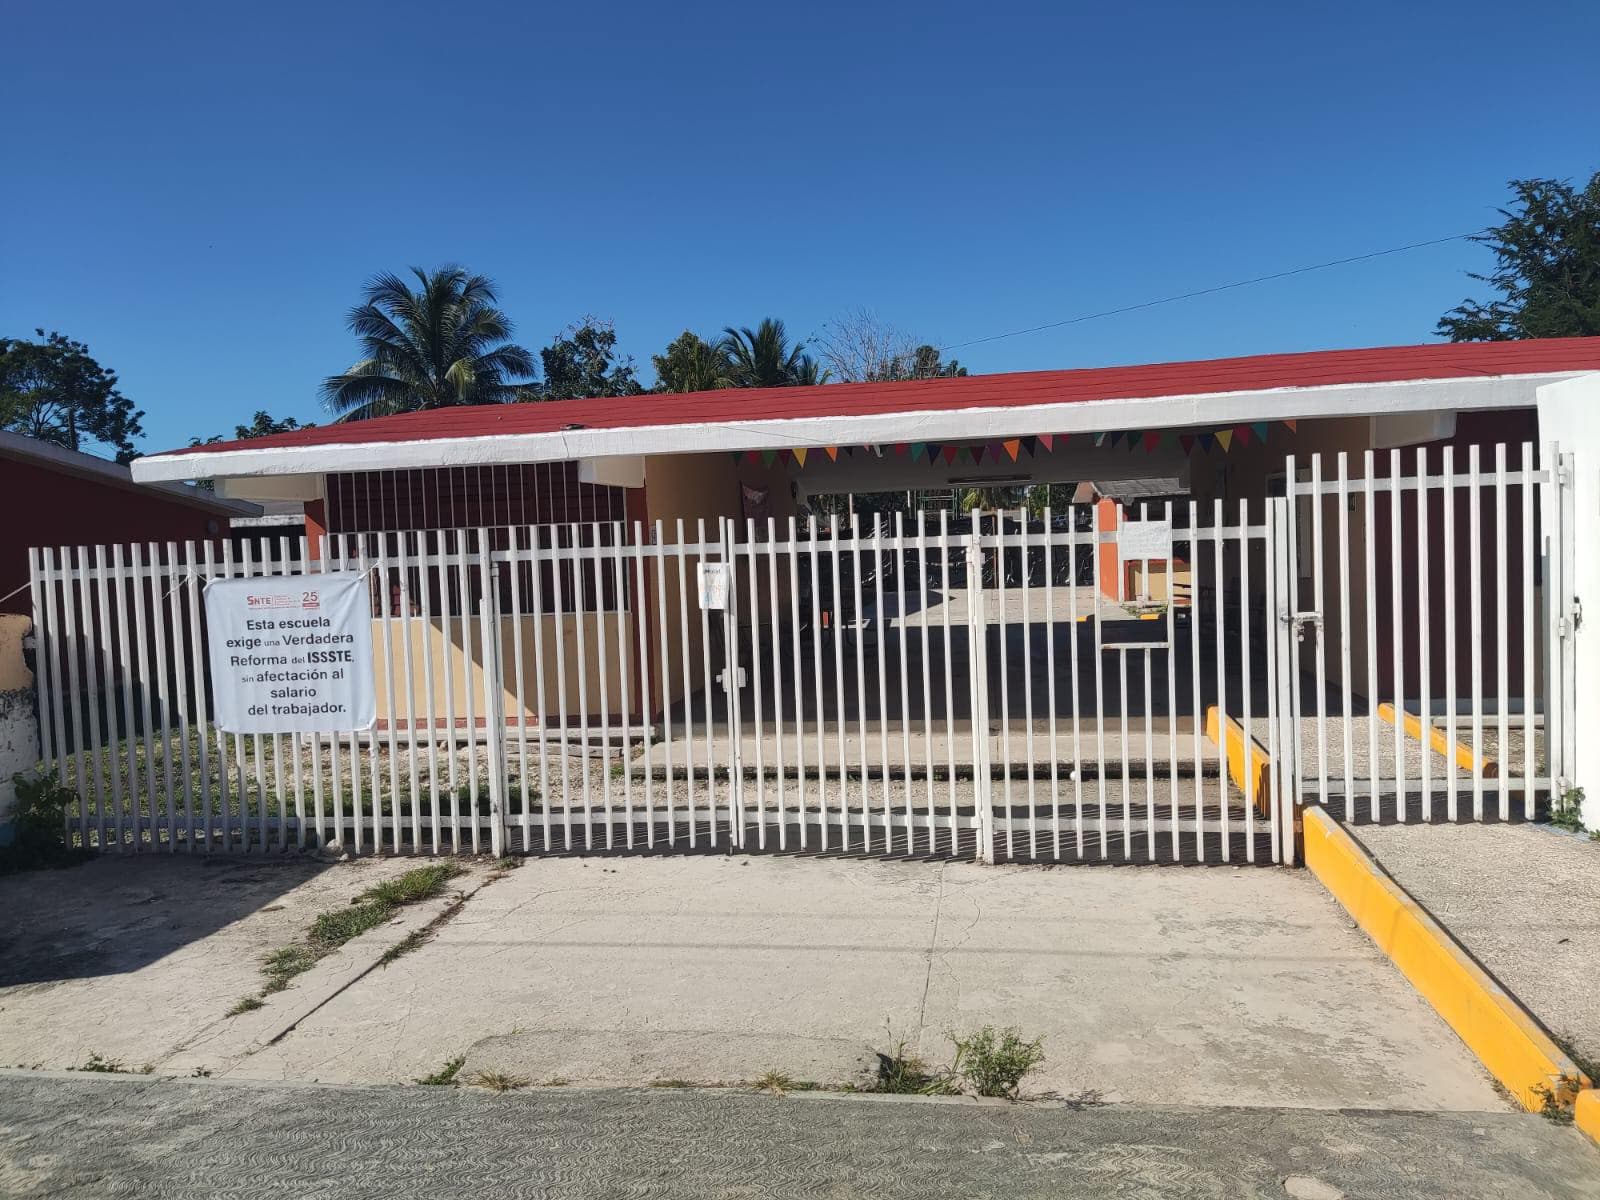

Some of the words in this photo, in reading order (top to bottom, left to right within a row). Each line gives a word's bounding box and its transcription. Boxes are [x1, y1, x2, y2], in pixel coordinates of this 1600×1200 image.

[302, 592, 318, 602] 25
[247, 620, 274, 630] Esta
[279, 617, 330, 629] escuela
[226, 637, 261, 650] exige
[282, 633, 354, 645] Verdadera
[231, 655, 287, 666] Reforma
[256, 670, 327, 682] afectación
[332, 668, 343, 679] al
[270, 687, 316, 698] salario
[248, 705, 268, 716] del
[272, 702, 346, 716] trabajador.
